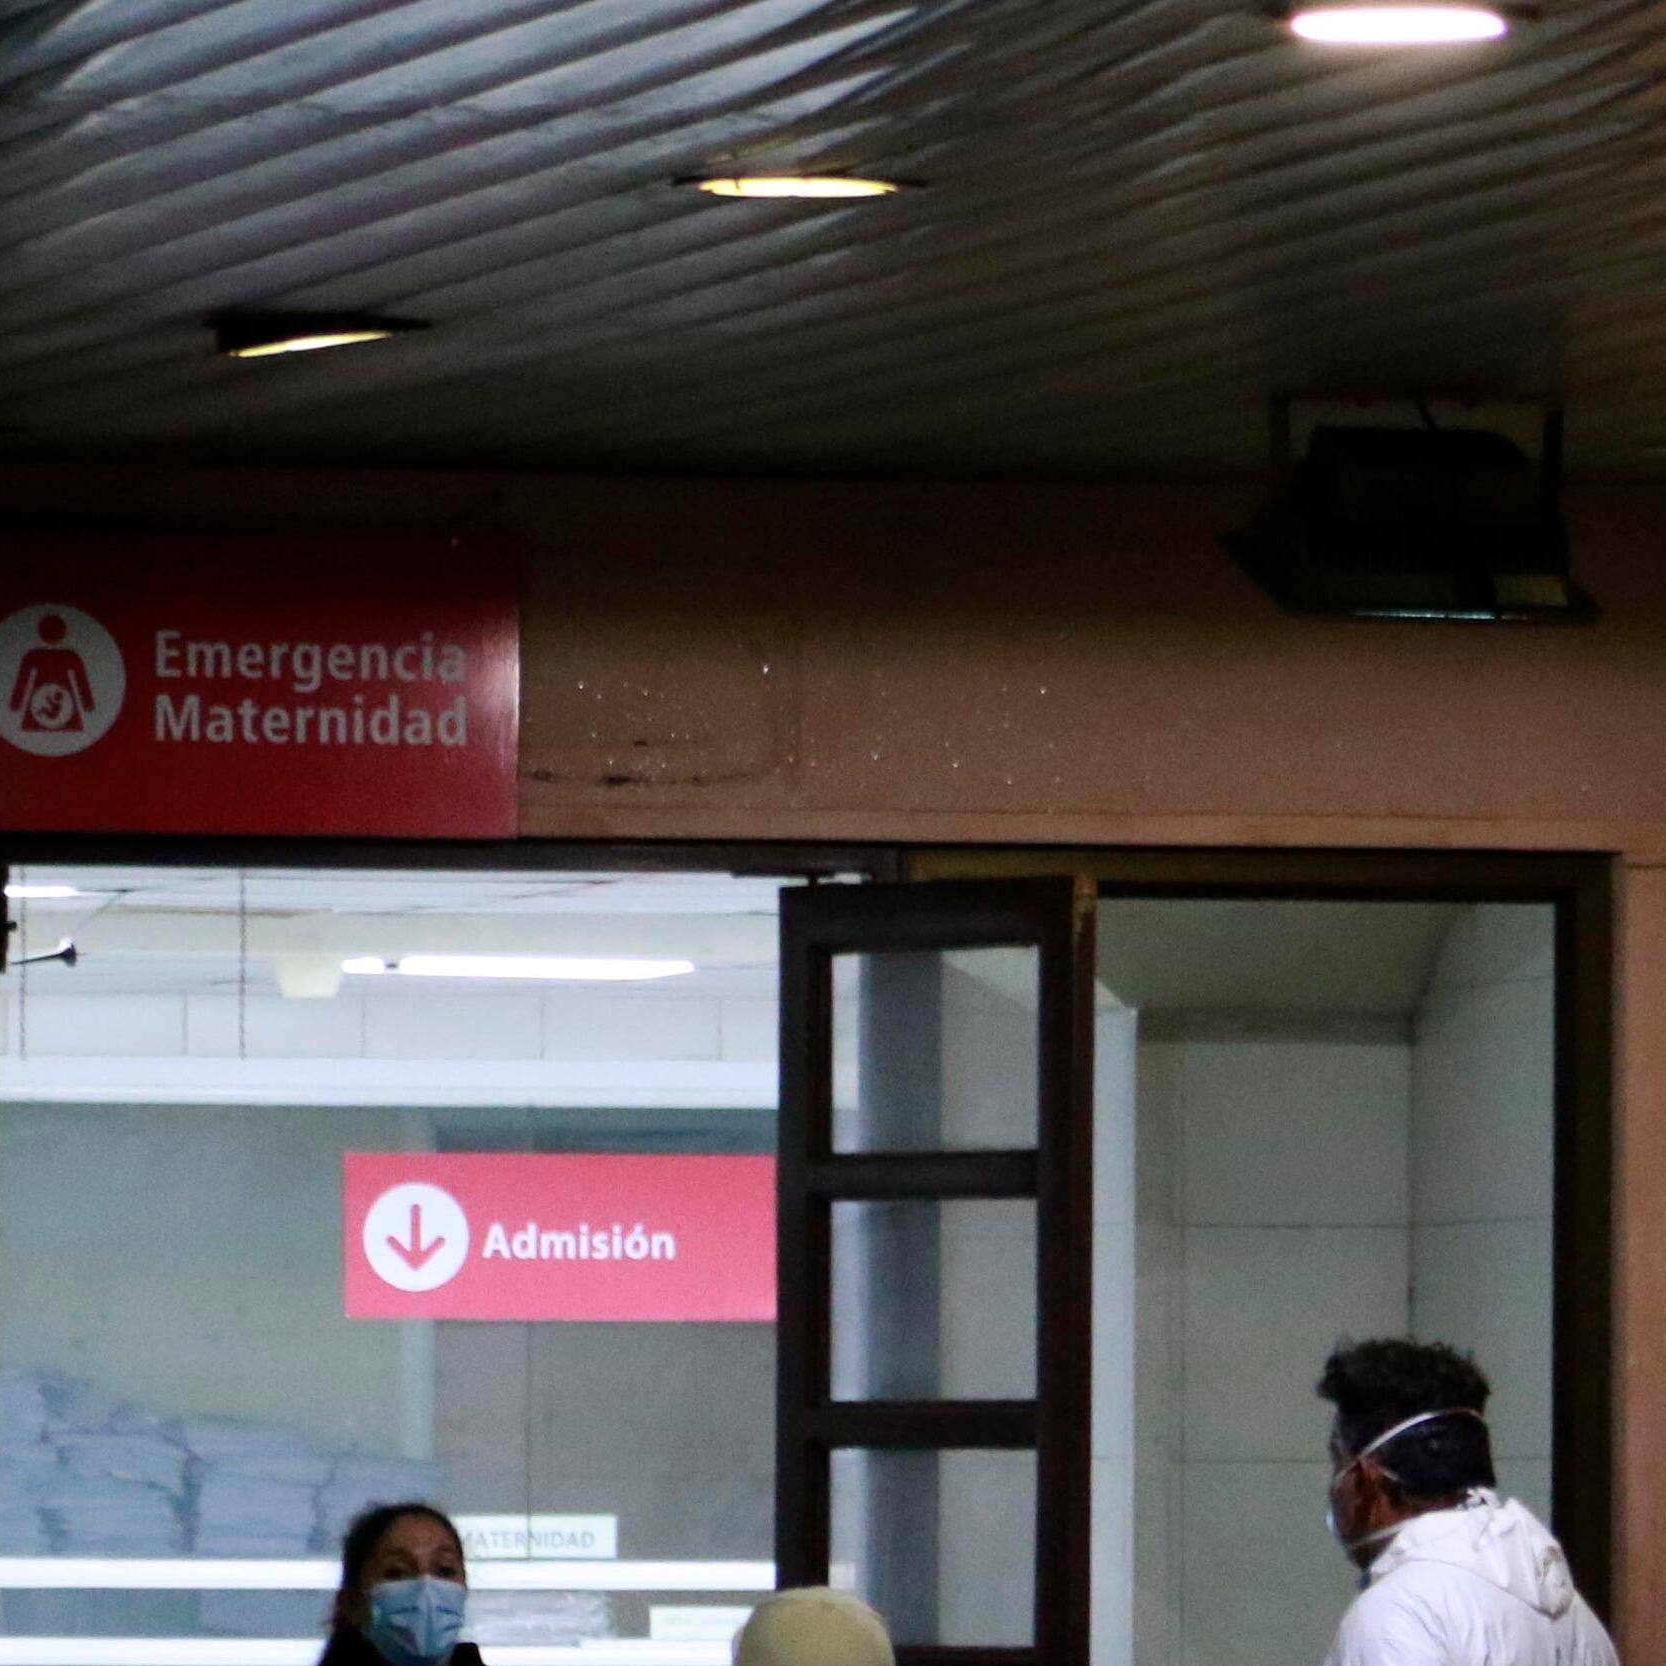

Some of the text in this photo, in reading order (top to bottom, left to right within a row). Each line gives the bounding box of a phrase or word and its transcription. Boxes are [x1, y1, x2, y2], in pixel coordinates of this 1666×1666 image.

[156, 629, 467, 692] Emergencia
[154, 694, 467, 746] Maternidad
[482, 1223, 676, 1259] Admisión
